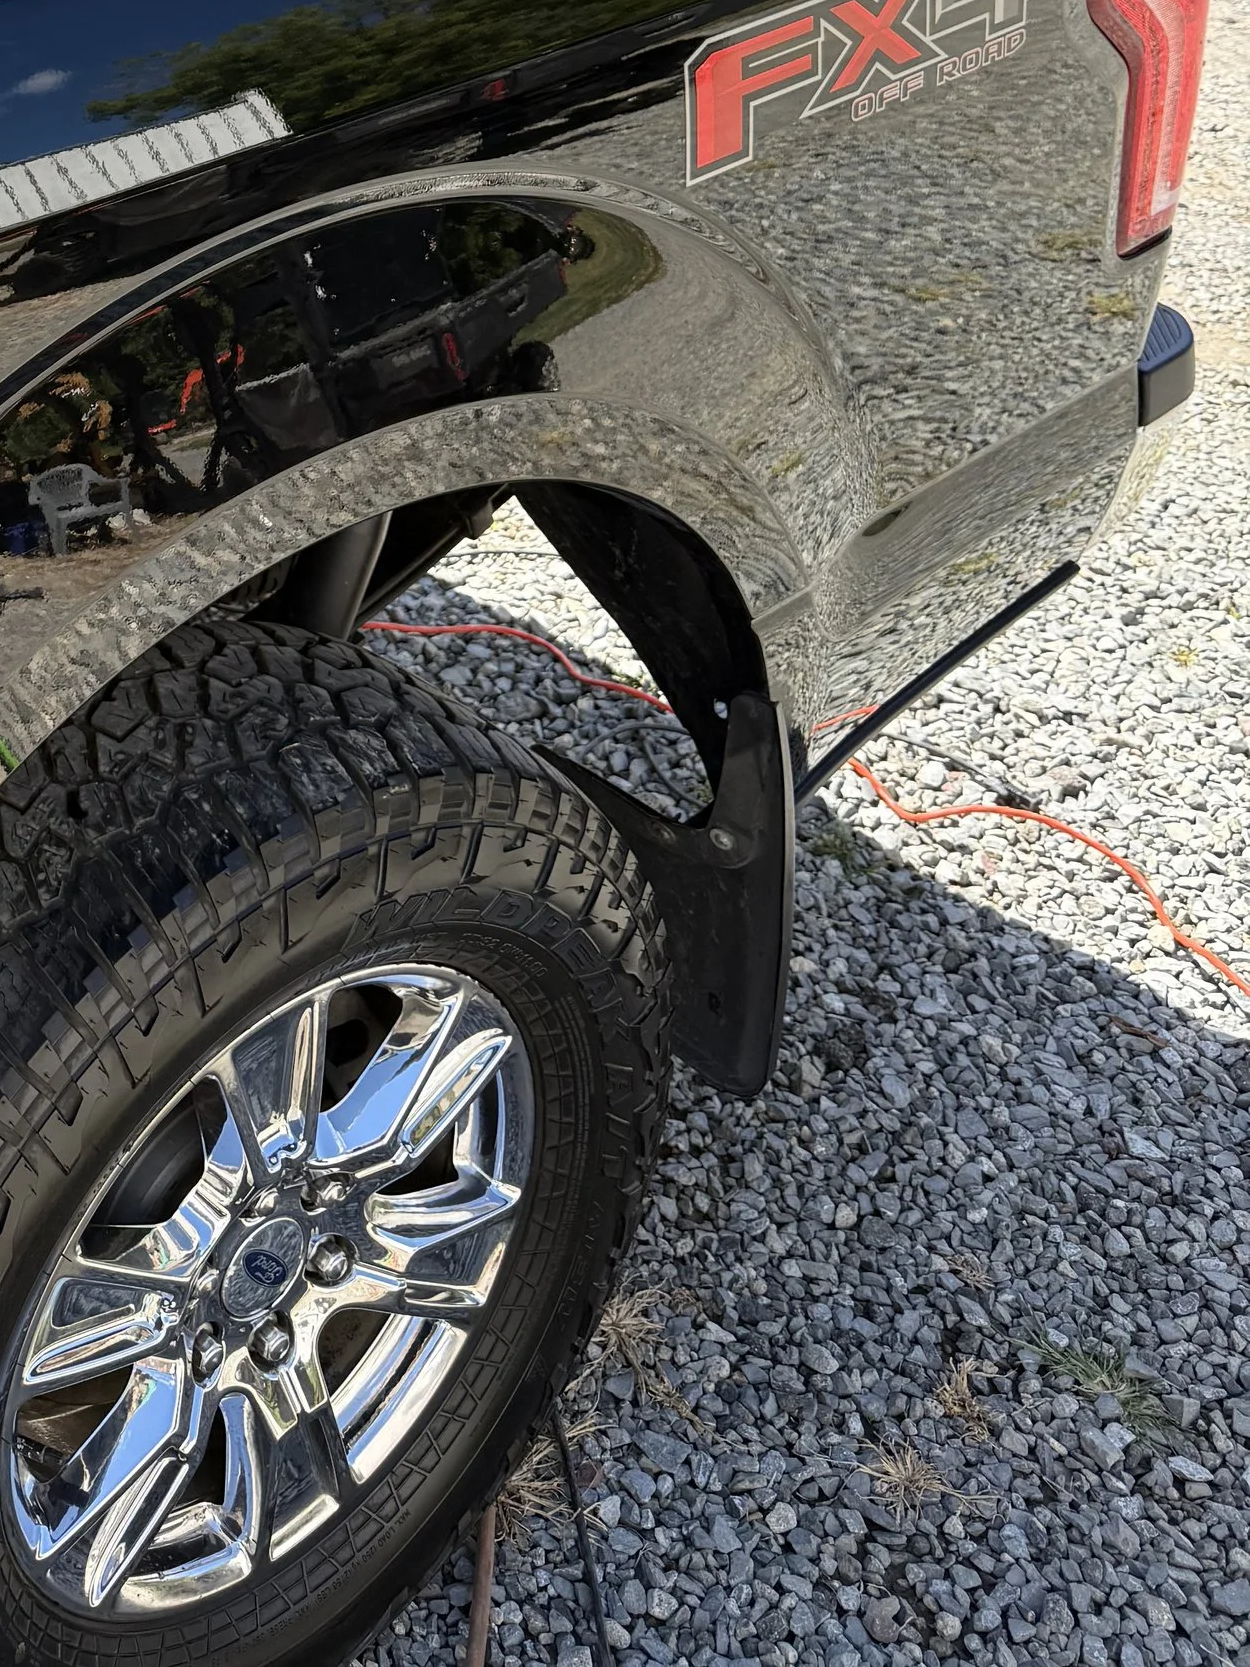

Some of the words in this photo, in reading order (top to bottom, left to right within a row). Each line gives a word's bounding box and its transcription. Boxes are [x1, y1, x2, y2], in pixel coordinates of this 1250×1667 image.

[851, 71, 925, 122] OFF
[937, 31, 1027, 86] ROAD
[339, 886, 632, 1042] WILDPEAK
[250, 1253, 285, 1284] Ford
